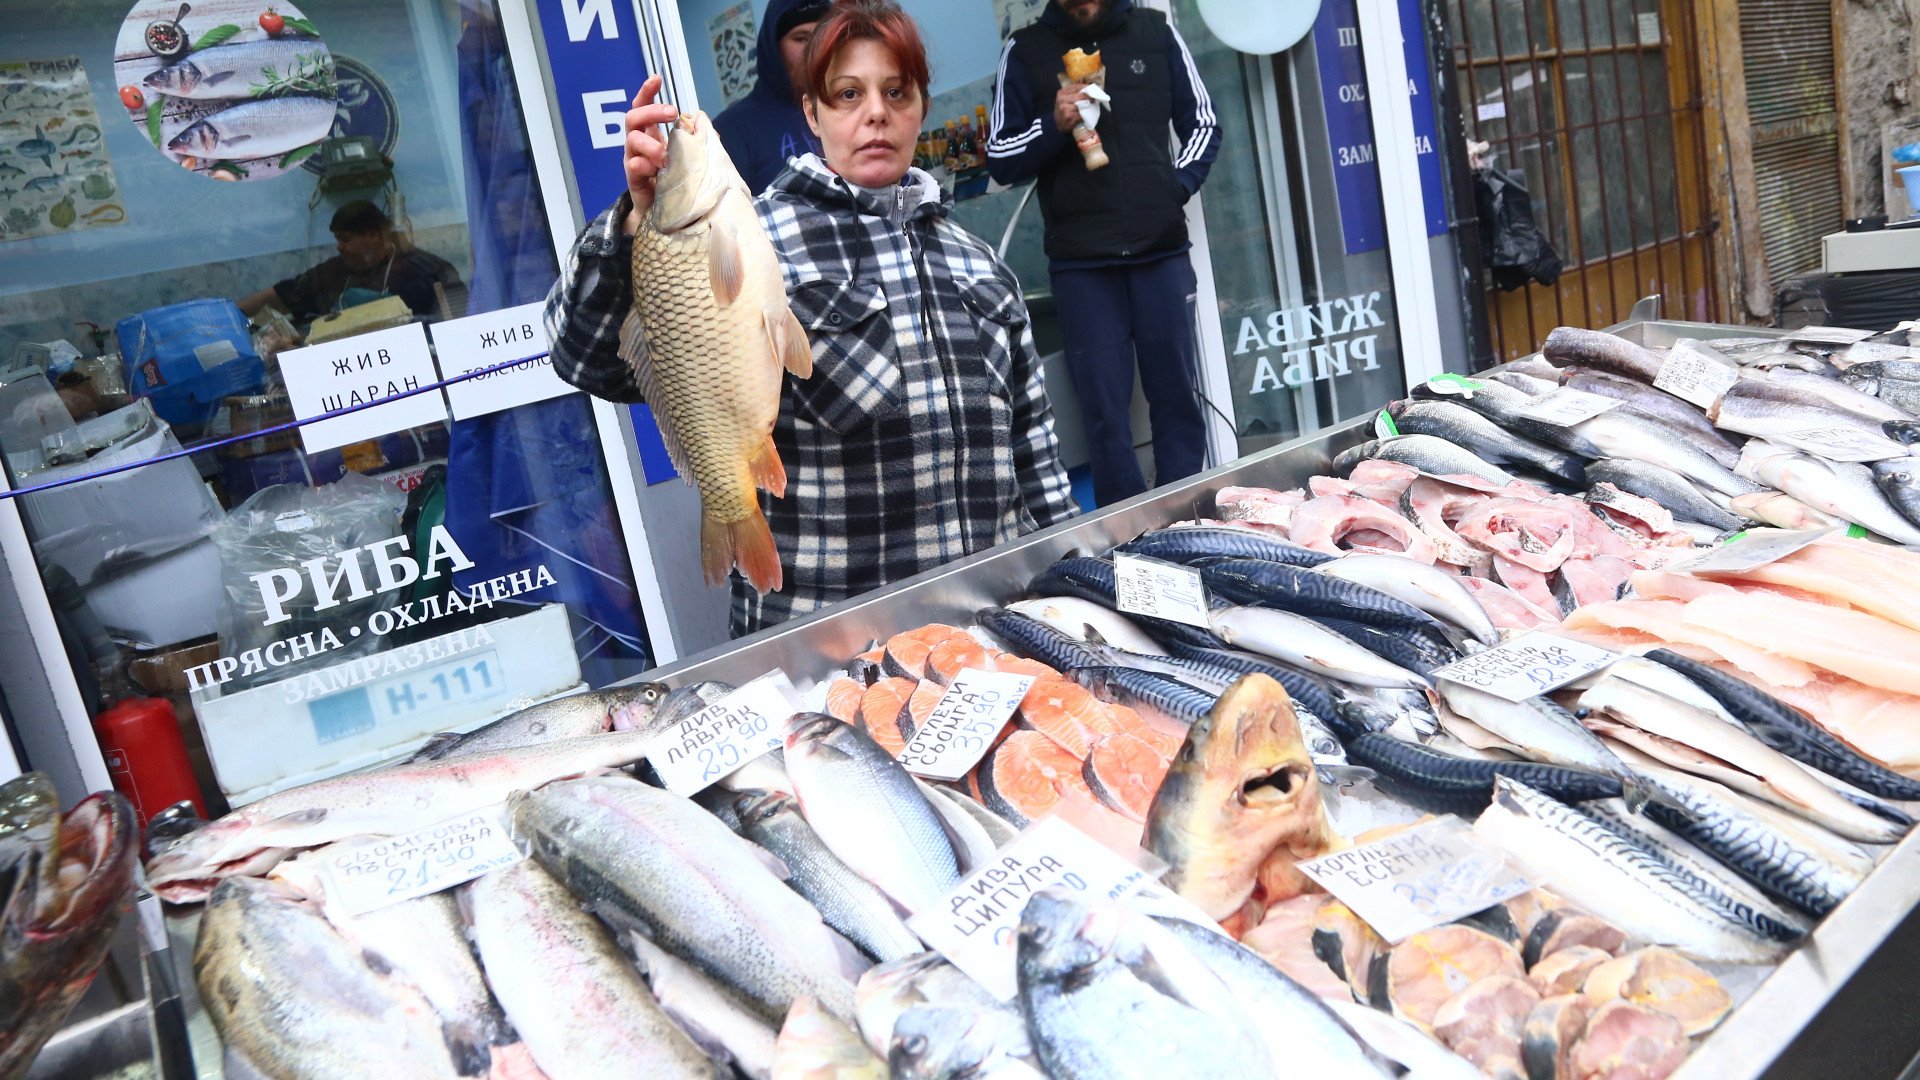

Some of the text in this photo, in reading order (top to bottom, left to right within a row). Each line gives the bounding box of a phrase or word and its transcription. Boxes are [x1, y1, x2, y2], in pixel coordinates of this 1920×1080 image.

[332, 348, 391, 377] ЖИВ
[479, 324, 534, 349] ЖИВ
[321, 375, 419, 413] ШАРАН
[463, 354, 551, 383] ТОЛСТОЛО
[249, 524, 475, 627] РИБА
[182, 564, 558, 693] ПРЯСНА ОХЛАДЕНА
[281, 623, 496, 704] ЗАМРАЗЕНА
[668, 705, 760, 764] ЛАВРАК
[680, 704, 727, 740] ДИВ
[900, 682, 968, 766] КОТЛЕТИ
[921, 693, 980, 765] СЬОМГА
[951, 857, 1022, 916] ДИВА
[1345, 844, 1454, 887] ЕСЕТРА
[954, 855, 1063, 936] ЦИПУРА
